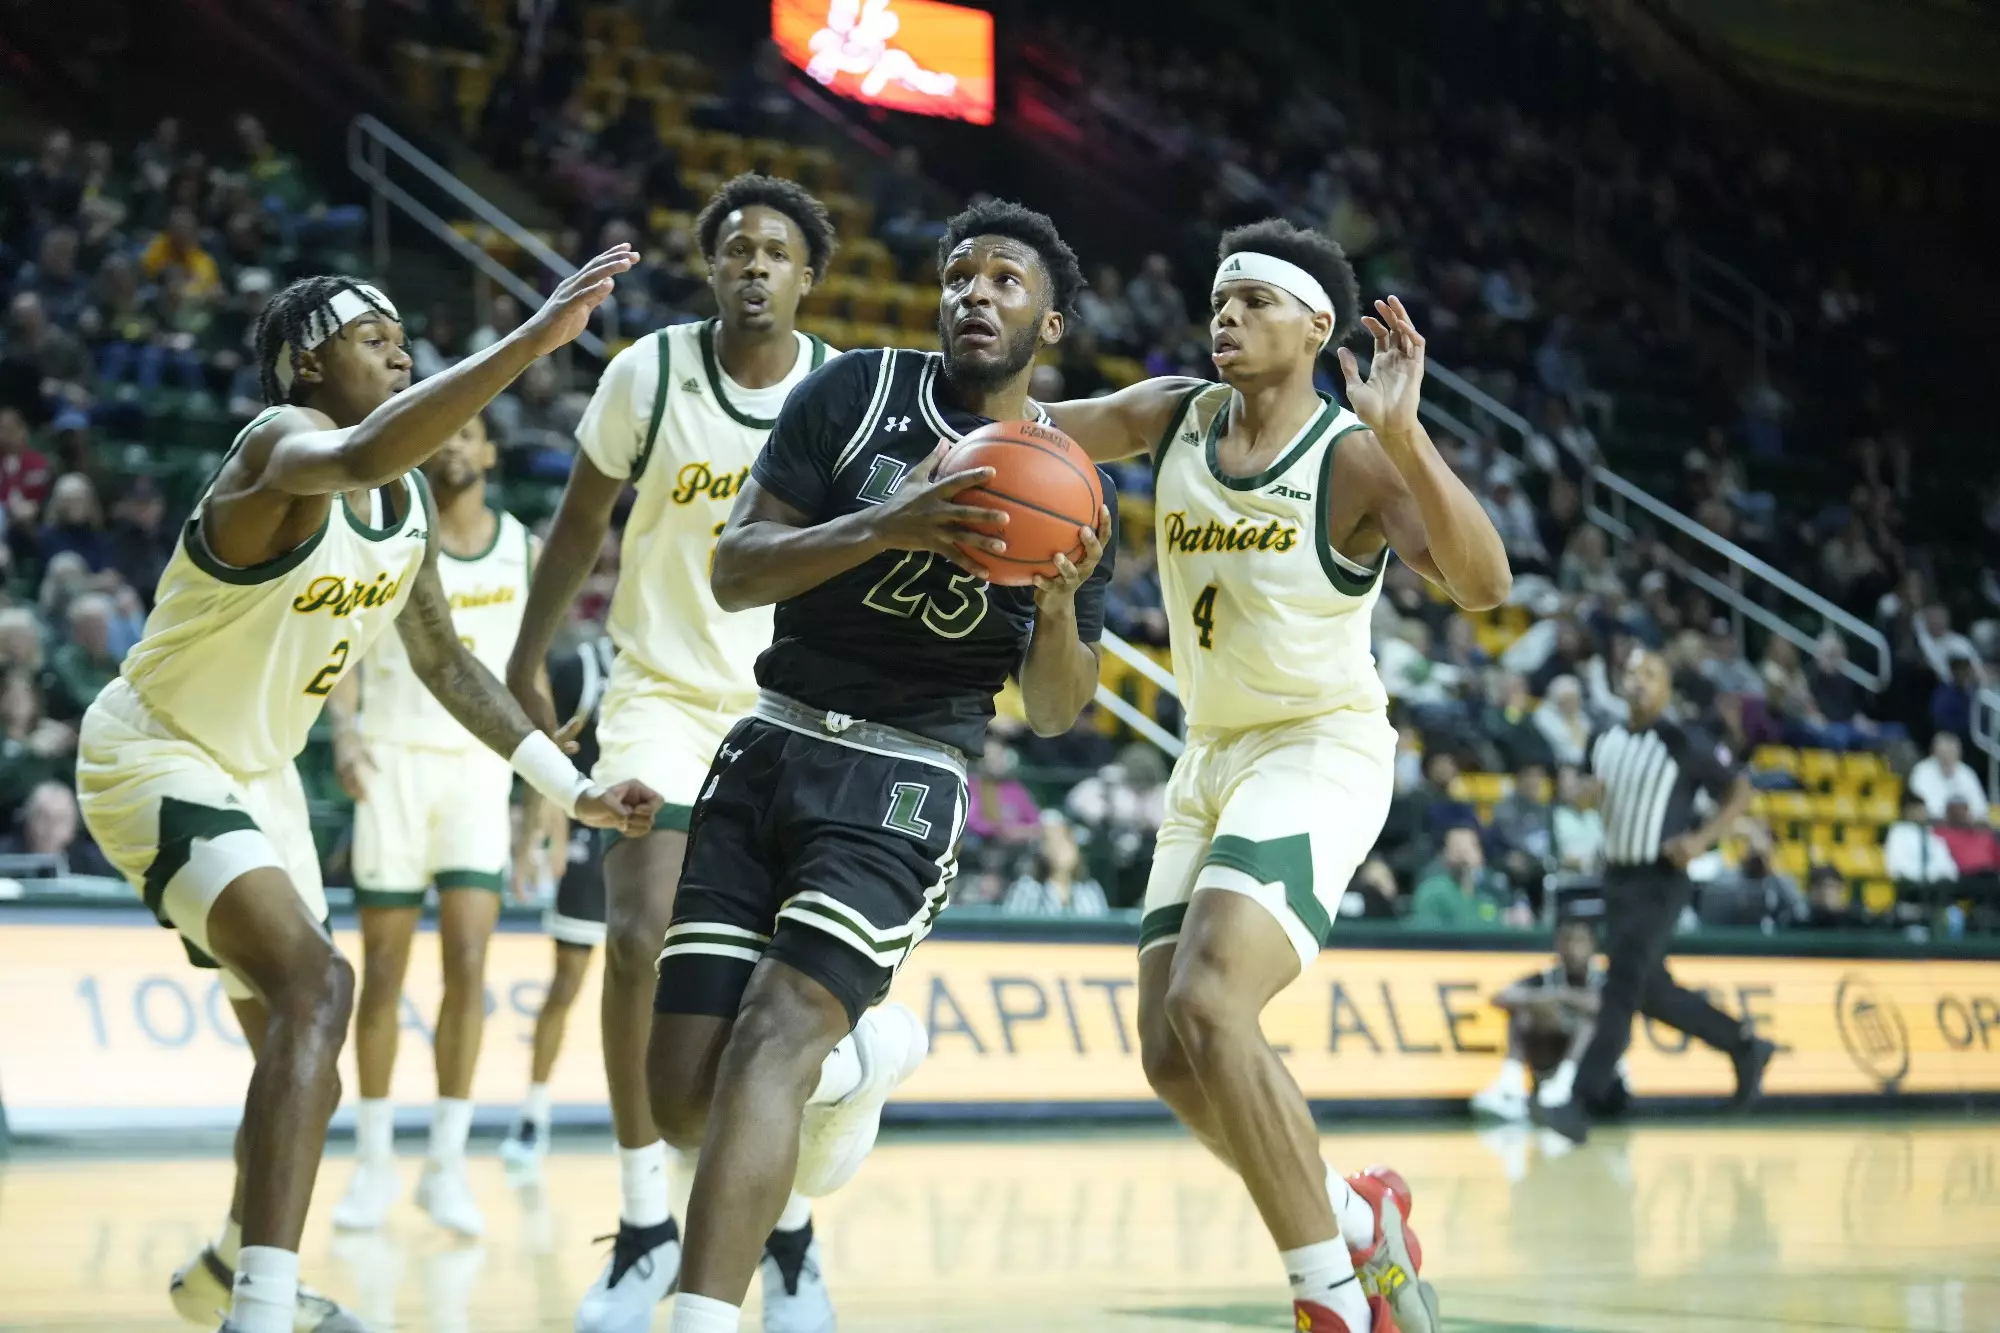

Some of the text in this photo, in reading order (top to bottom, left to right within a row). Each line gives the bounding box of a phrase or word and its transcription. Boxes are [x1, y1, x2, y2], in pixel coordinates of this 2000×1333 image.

[1164, 511, 1298, 554] Patriots
[862, 550, 990, 640] 23
[1192, 584, 1219, 650] 4
[303, 639, 350, 695] 2
[882, 781, 932, 840] L
[1327, 978, 1497, 1056] ALE
